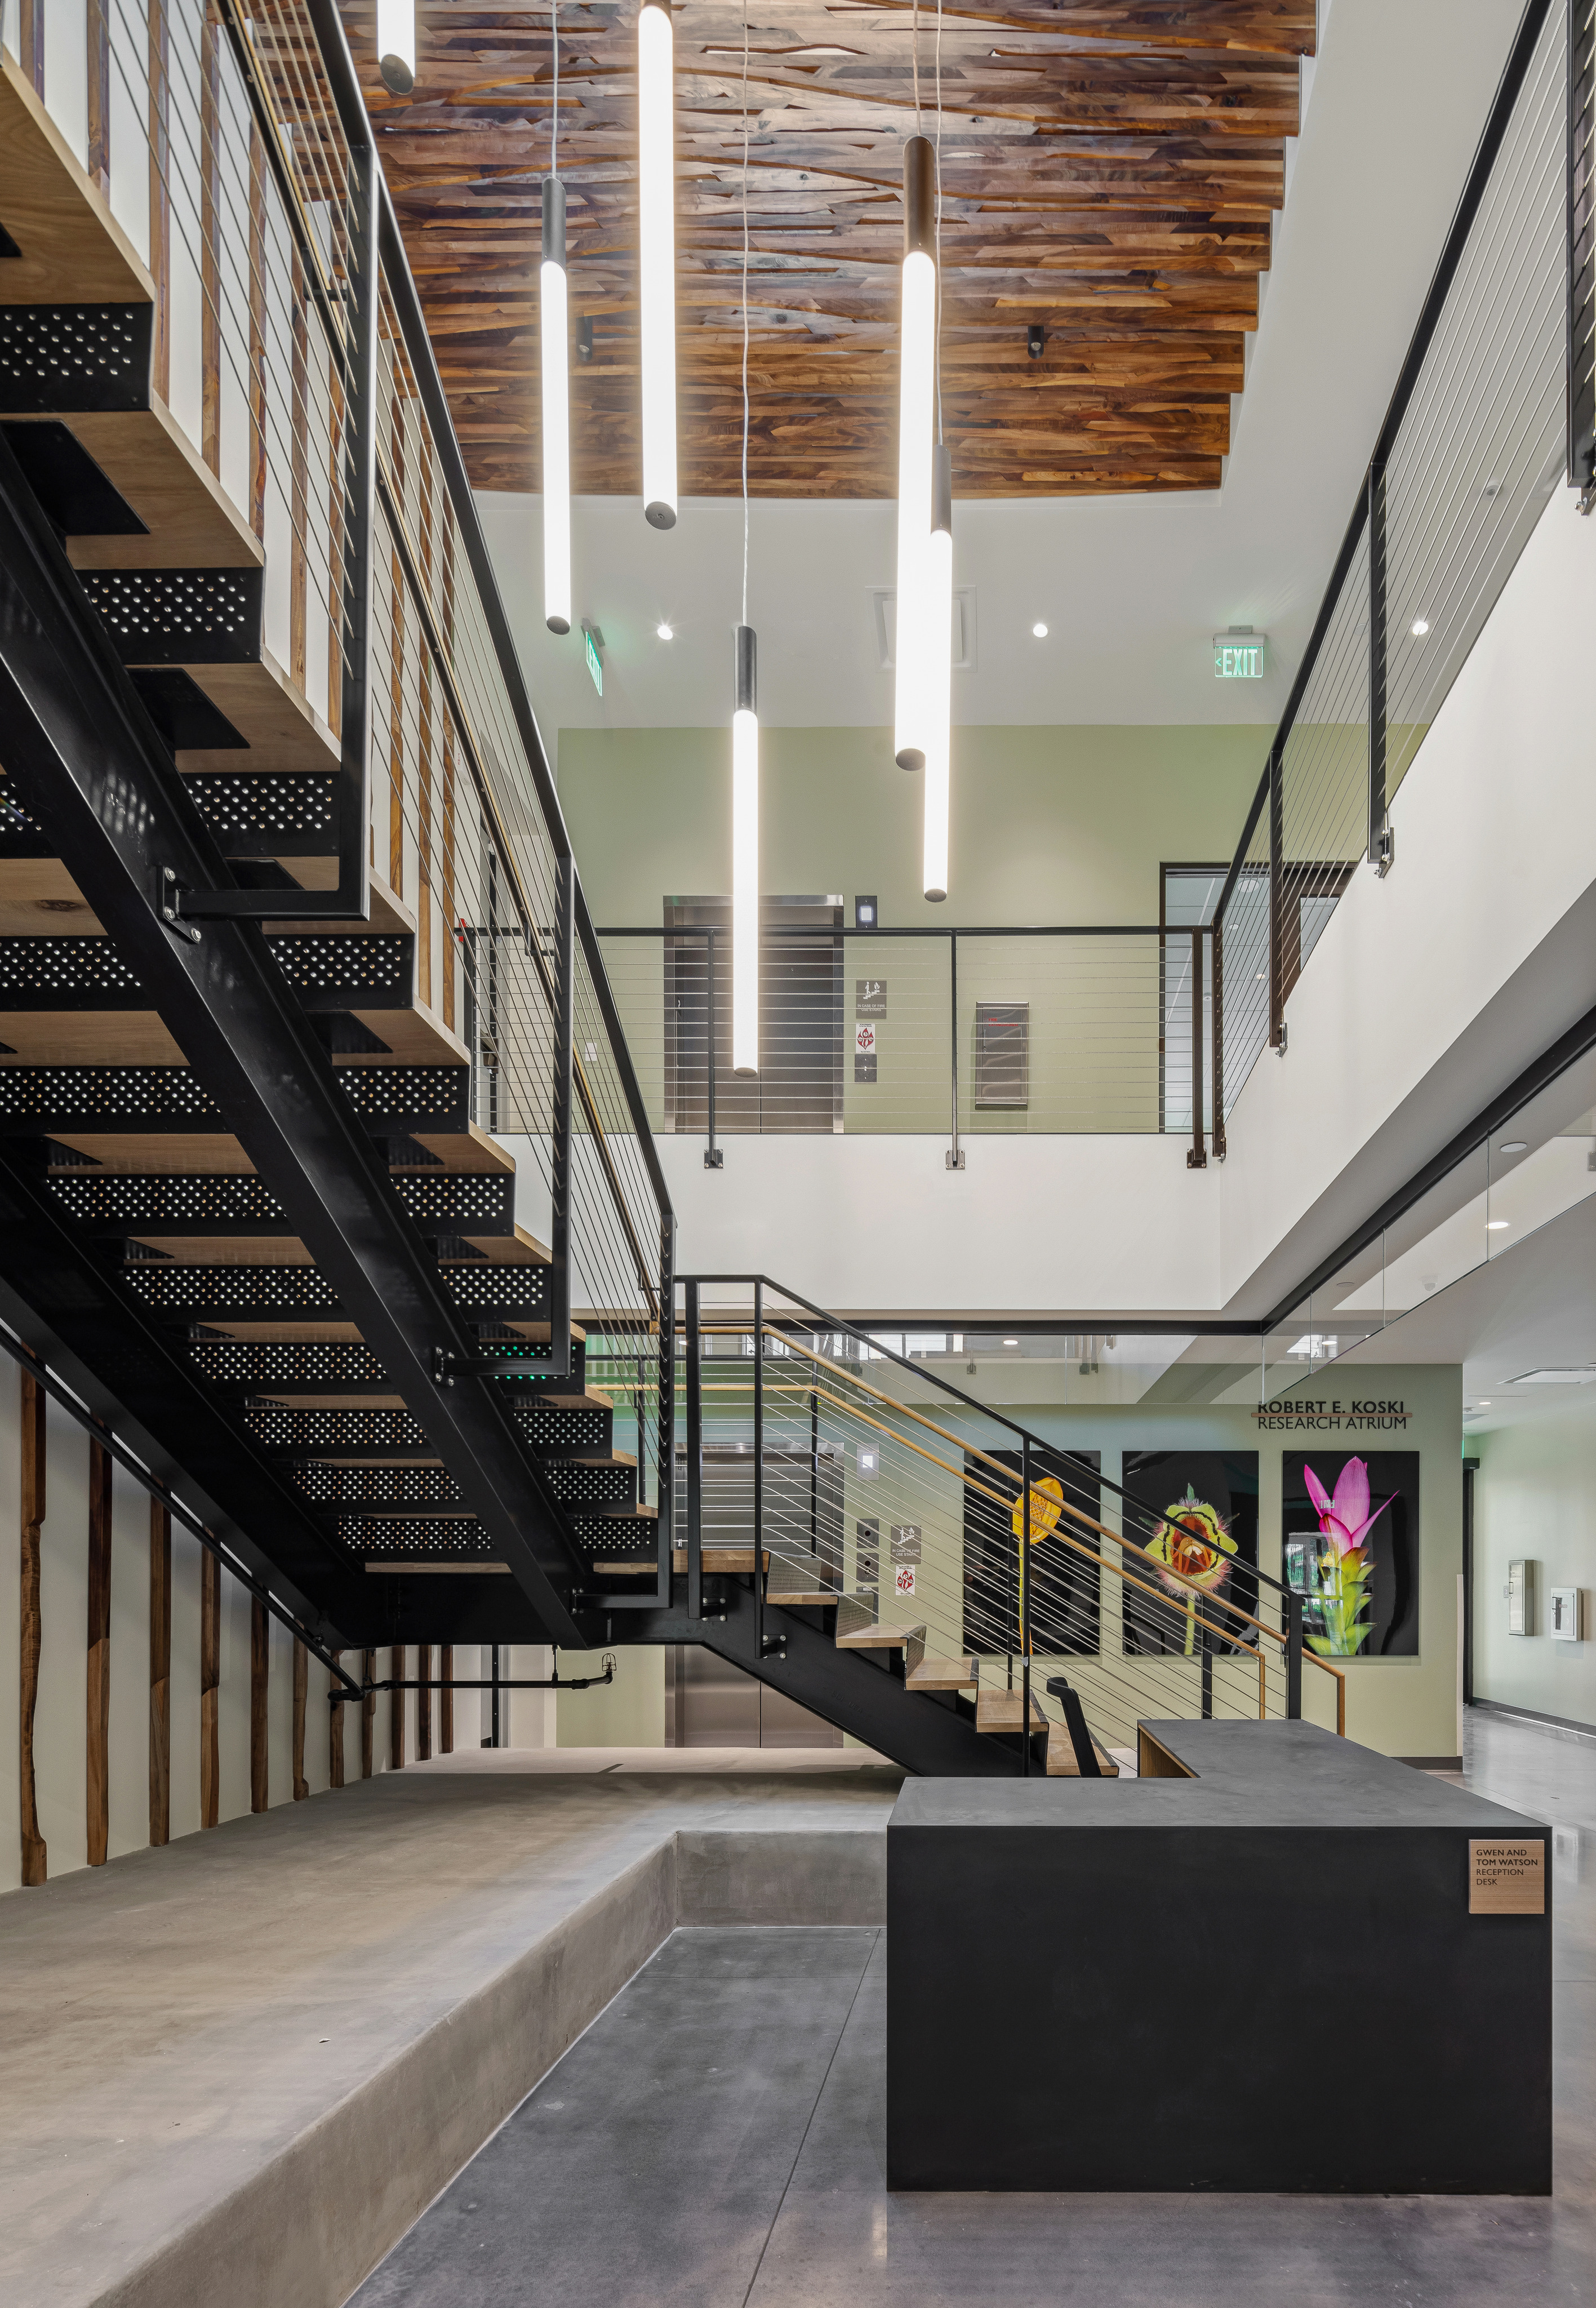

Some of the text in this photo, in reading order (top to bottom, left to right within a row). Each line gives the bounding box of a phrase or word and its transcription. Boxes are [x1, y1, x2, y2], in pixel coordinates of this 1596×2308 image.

[1222, 649, 1257, 675] EXIT
[1258, 1401, 1404, 1413] ROBERT E. KOSKI
[1259, 1417, 1406, 1430] RESEARCH ATRIUM
